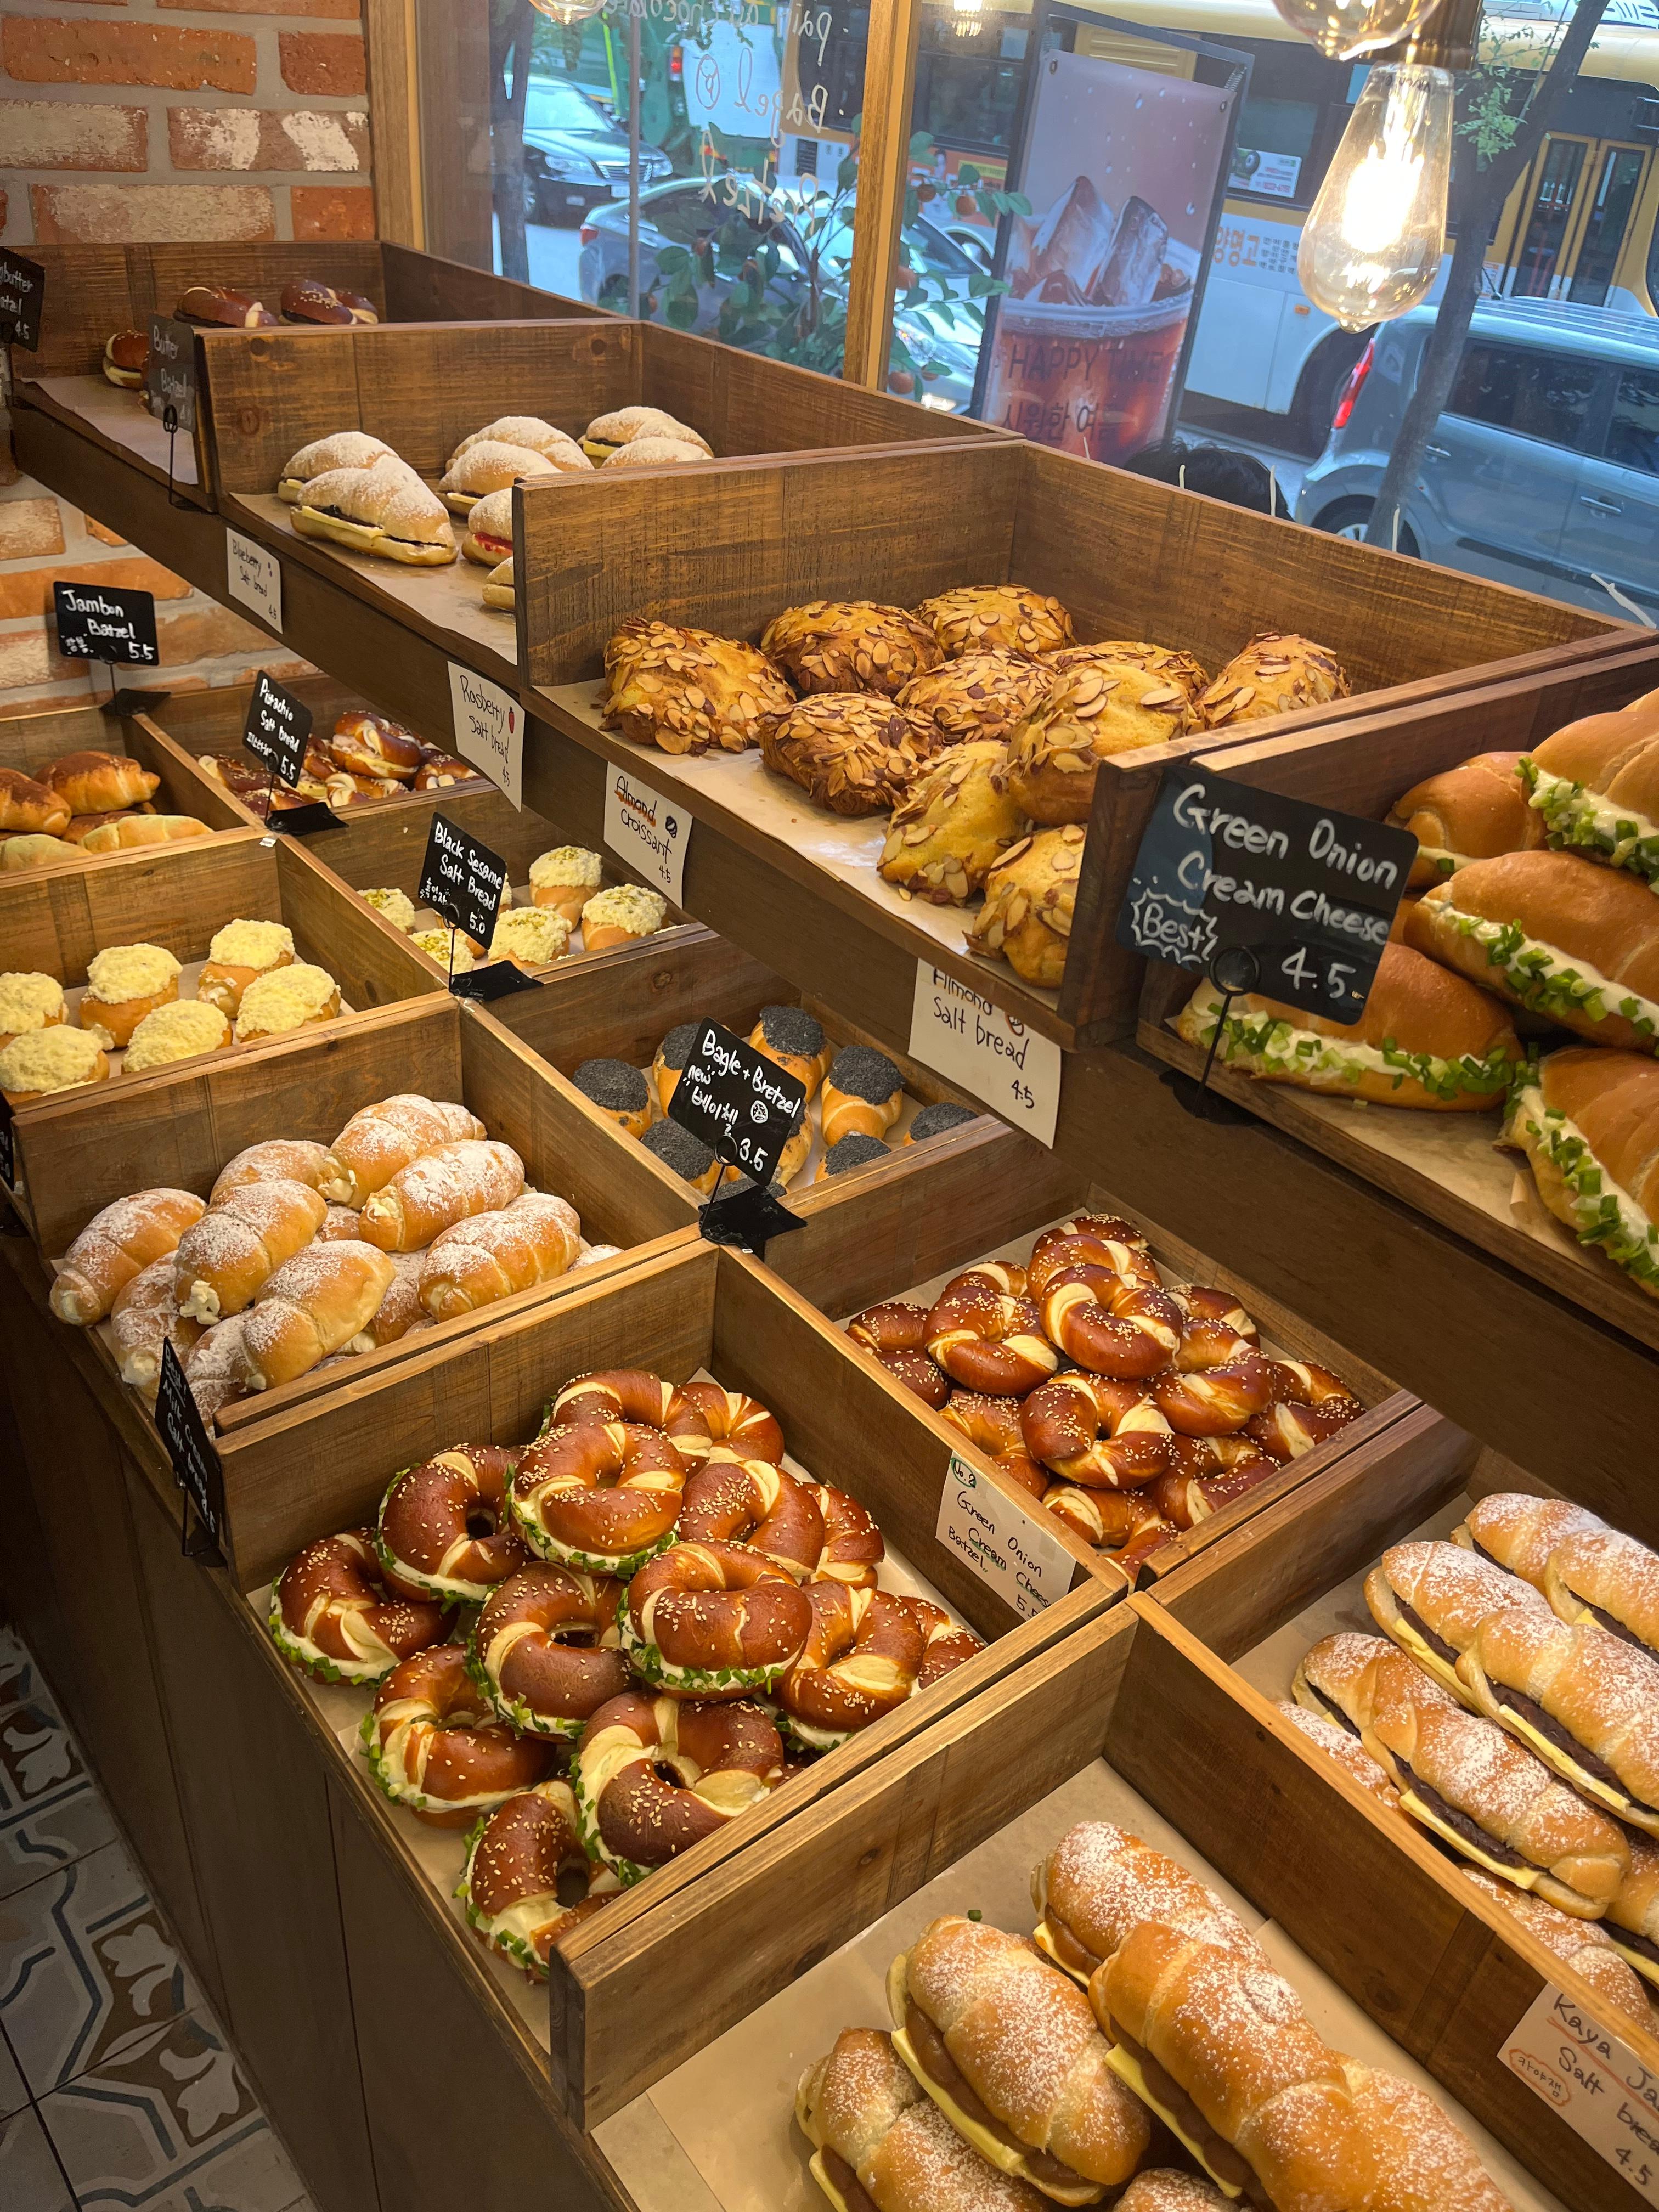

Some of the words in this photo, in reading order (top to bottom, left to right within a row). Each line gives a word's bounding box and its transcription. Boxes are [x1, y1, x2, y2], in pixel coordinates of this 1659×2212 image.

[1008, 343, 1097, 380] HAPPY
[1002, 402, 1070, 441] 시원한
[61, 589, 124, 617] Jambon
[128, 641, 154, 660] 5.5
[278, 725, 300, 753] bread
[469, 715, 488, 741] Salt
[491, 725, 509, 764] bread
[280, 755, 296, 780] 5.5
[616, 775, 657, 822] Almond
[434, 821, 465, 859] Black
[467, 849, 503, 890] Sesame
[1172, 783, 1289, 860] Green
[1308, 818, 1398, 890] Onion
[439, 854, 464, 885] Salt
[467, 875, 496, 911] Bread
[659, 865, 672, 883] 4.5
[1177, 850, 1285, 916] Cream
[1289, 889, 1392, 946] Cheese
[469, 911, 486, 934] 5.0
[1142, 902, 1206, 950] Best
[1280, 946, 1357, 999] 4.5
[934, 996, 966, 1034] Salt
[975, 1014, 1030, 1070] bread
[702, 1029, 741, 1077] Bagle
[752, 1065, 802, 1118] Bretzel
[1011, 1079, 1035, 1109] 4.5
[739, 1137, 769, 1172] 3.5
[947, 1525, 984, 1569] Batzel
[957, 1491, 996, 1535] Green
[1007, 1536, 1042, 1578] Onion
[968, 1527, 1007, 1571] Cream
[1015, 1571, 1052, 1609] Chees
[1553, 1993, 1611, 2060] Kaya
[1626, 2066, 1659, 2113] Ja
[1517, 2056, 1562, 2098] 카야잼
[1558, 2046, 1605, 2096] Salt
[1616, 2102, 1659, 2157] brea
[1615, 2147, 1654, 2186] 4.5
